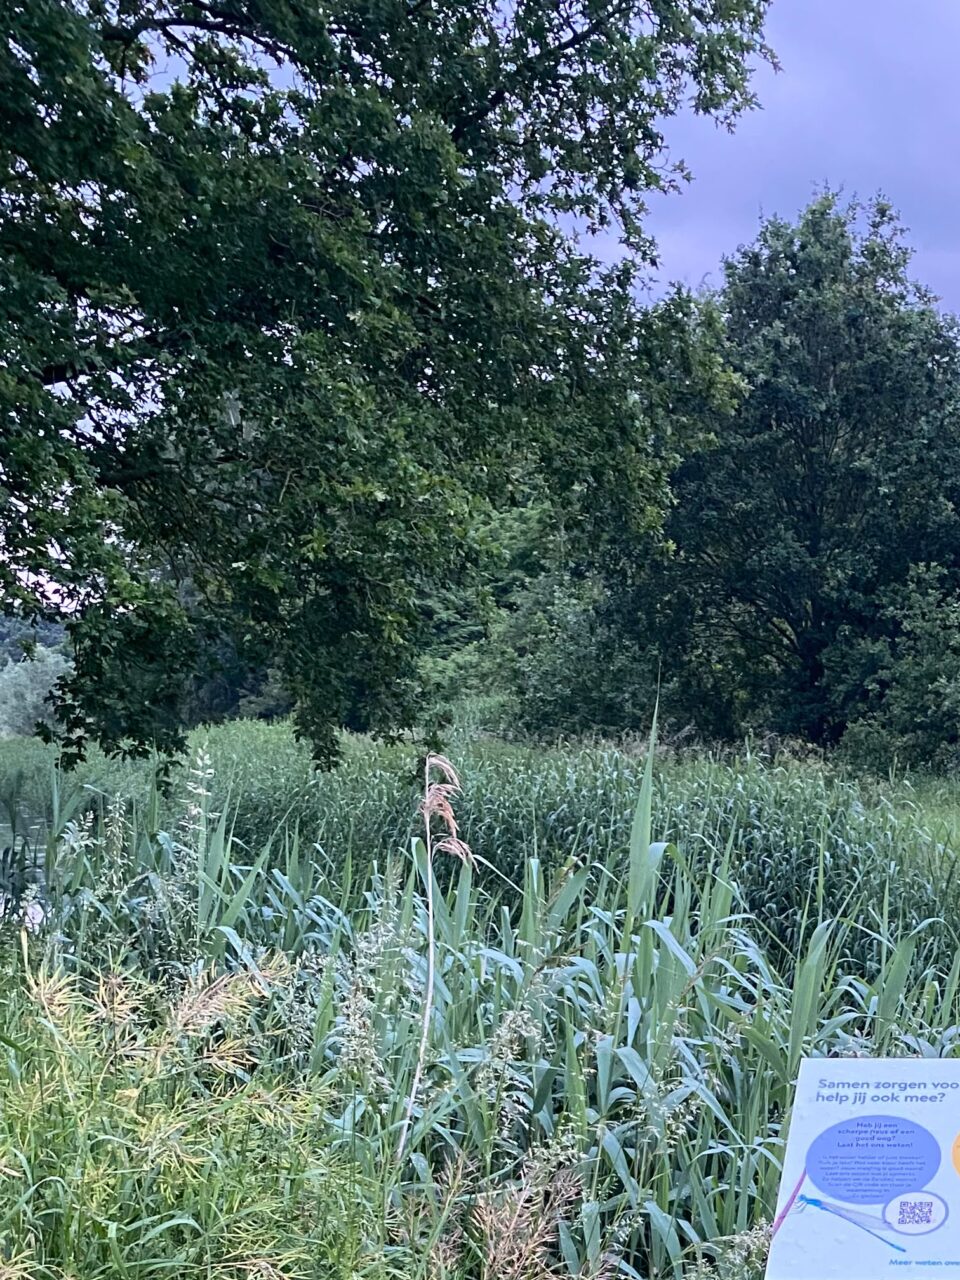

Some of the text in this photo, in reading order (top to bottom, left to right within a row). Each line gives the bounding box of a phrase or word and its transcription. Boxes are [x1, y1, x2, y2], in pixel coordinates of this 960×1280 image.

[818, 1079, 870, 1090] Samen
[873, 1081, 927, 1092] zorgen
[815, 1092, 946, 1105] help jij ook mee?
[889, 1258, 913, 1266] Meer
